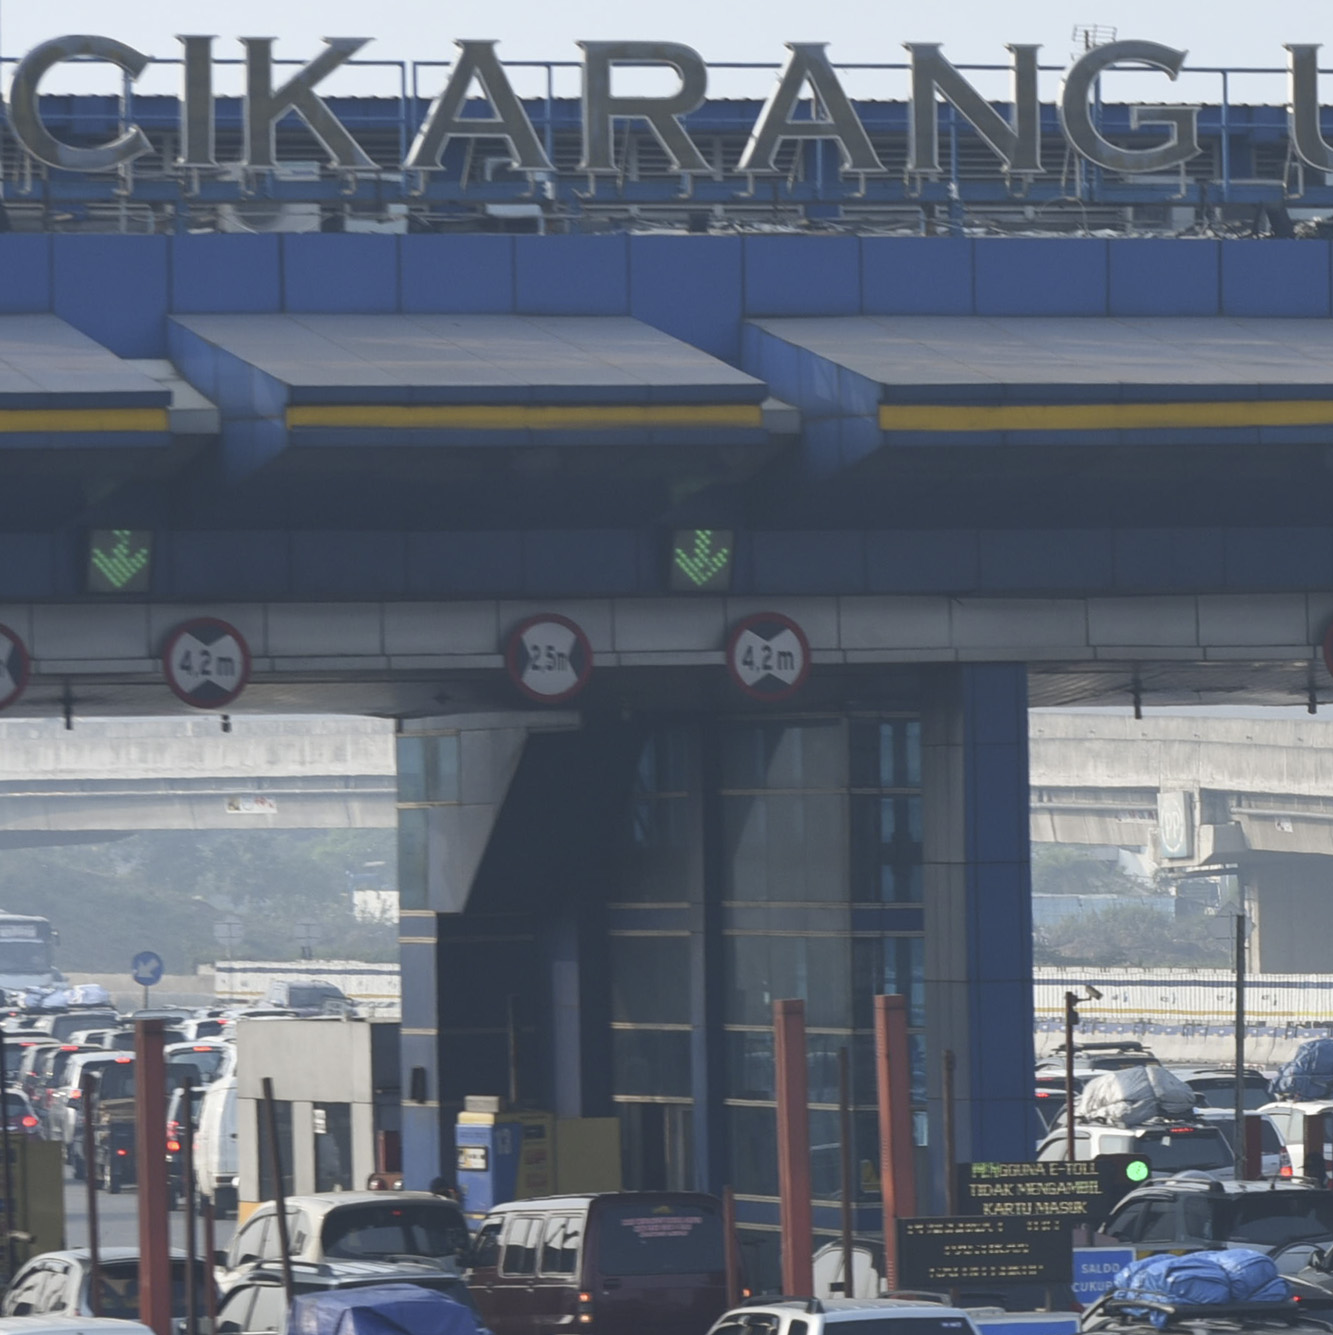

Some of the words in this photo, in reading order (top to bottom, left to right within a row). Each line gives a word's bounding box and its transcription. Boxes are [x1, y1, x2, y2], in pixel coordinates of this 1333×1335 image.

[9, 34, 1202, 173] CIKARANG
[969, 1183, 1014, 1196] TIDAK
[983, 1202, 1033, 1216] KARTU
[1035, 1201, 1088, 1214] MASUK
[1081, 1263, 1120, 1275] SALDO
